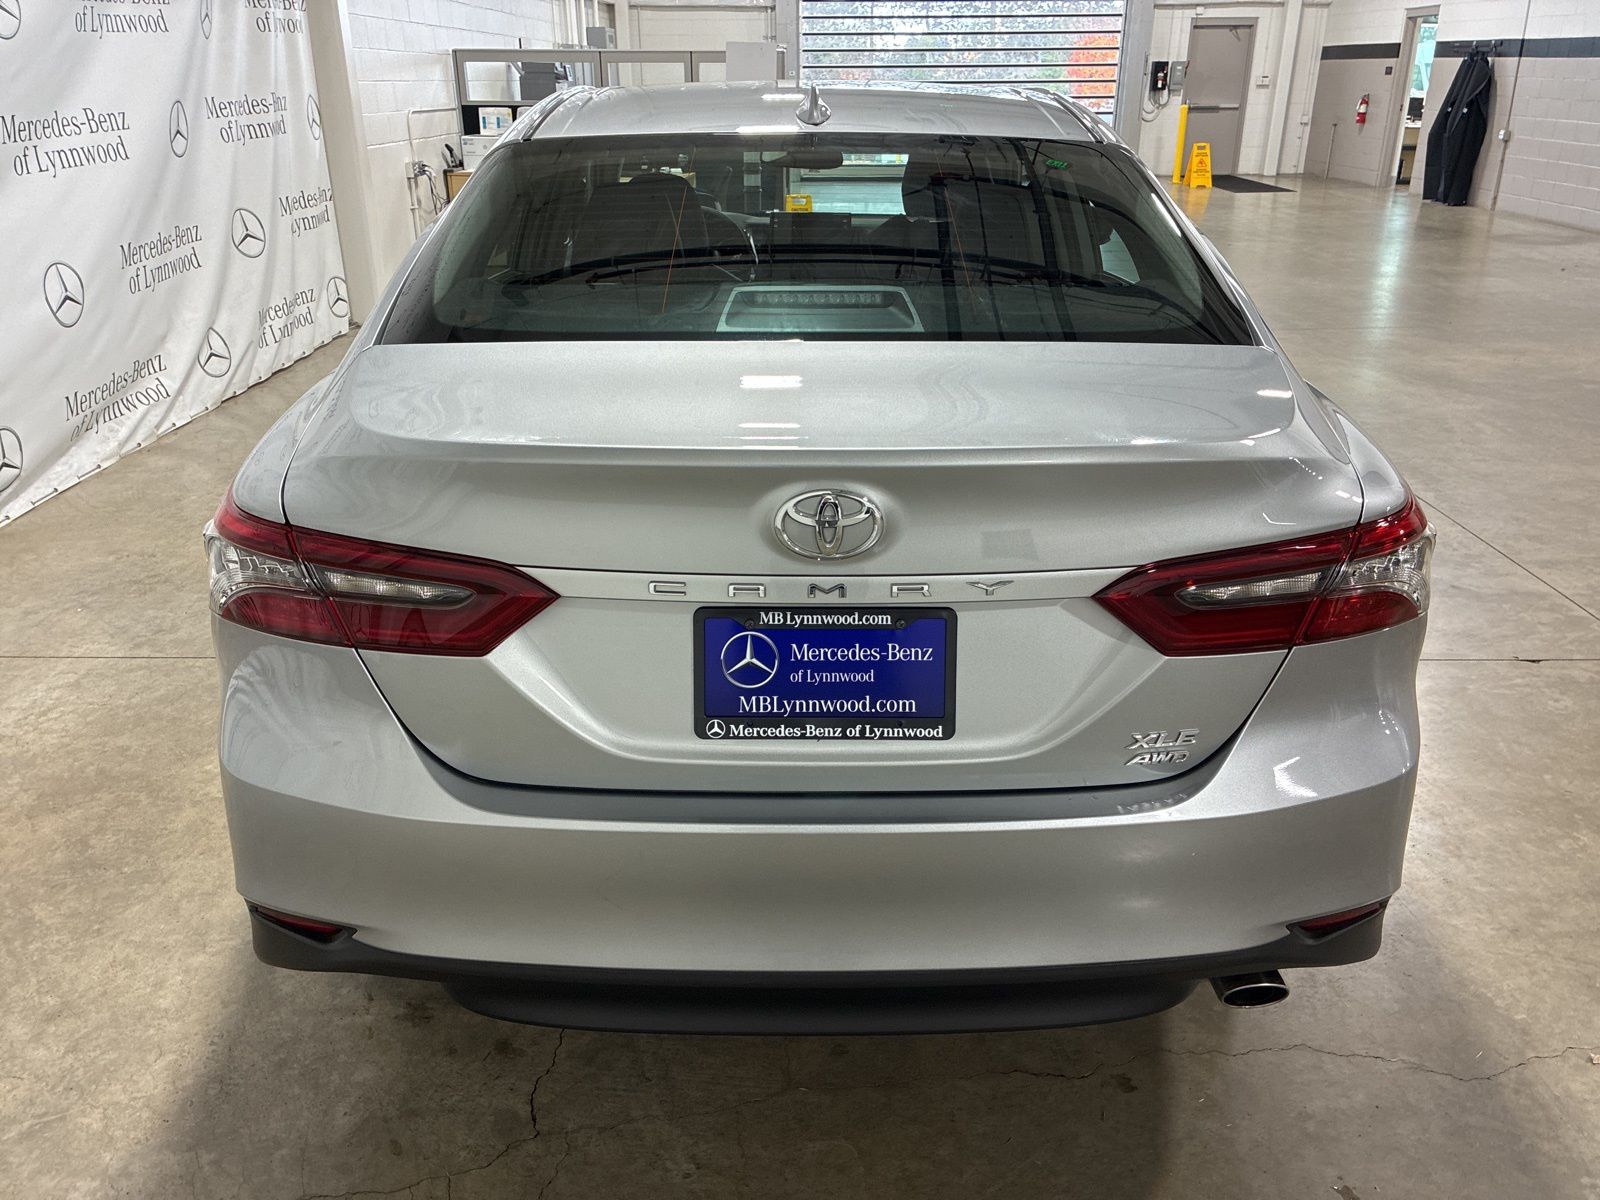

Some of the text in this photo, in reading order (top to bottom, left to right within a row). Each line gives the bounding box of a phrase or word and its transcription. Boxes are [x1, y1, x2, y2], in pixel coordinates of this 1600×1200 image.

[75, 5, 169, 39] of Lynnwood
[0, 107, 130, 144] Mercedes-Benz
[220, 120, 235, 143] of
[14, 135, 130, 178] of Lynnwood
[120, 225, 202, 269] Mercedes-Benz
[129, 246, 202, 294] of Lynnwood
[65, 354, 167, 421] Mercedes-Benz
[70, 377, 171, 442] of Lynnwood
[648, 580, 1014, 597] CAMRY
[790, 643, 933, 661] Mercedes-Benz
[790, 669, 875, 686] of Lynnwood
[738, 695, 917, 717] MBLynnwood.com
[729, 724, 943, 740] Mercedes-Benz of Lynnwood
[1124, 728, 1199, 750] XLE
[1124, 750, 1190, 767] AWD
